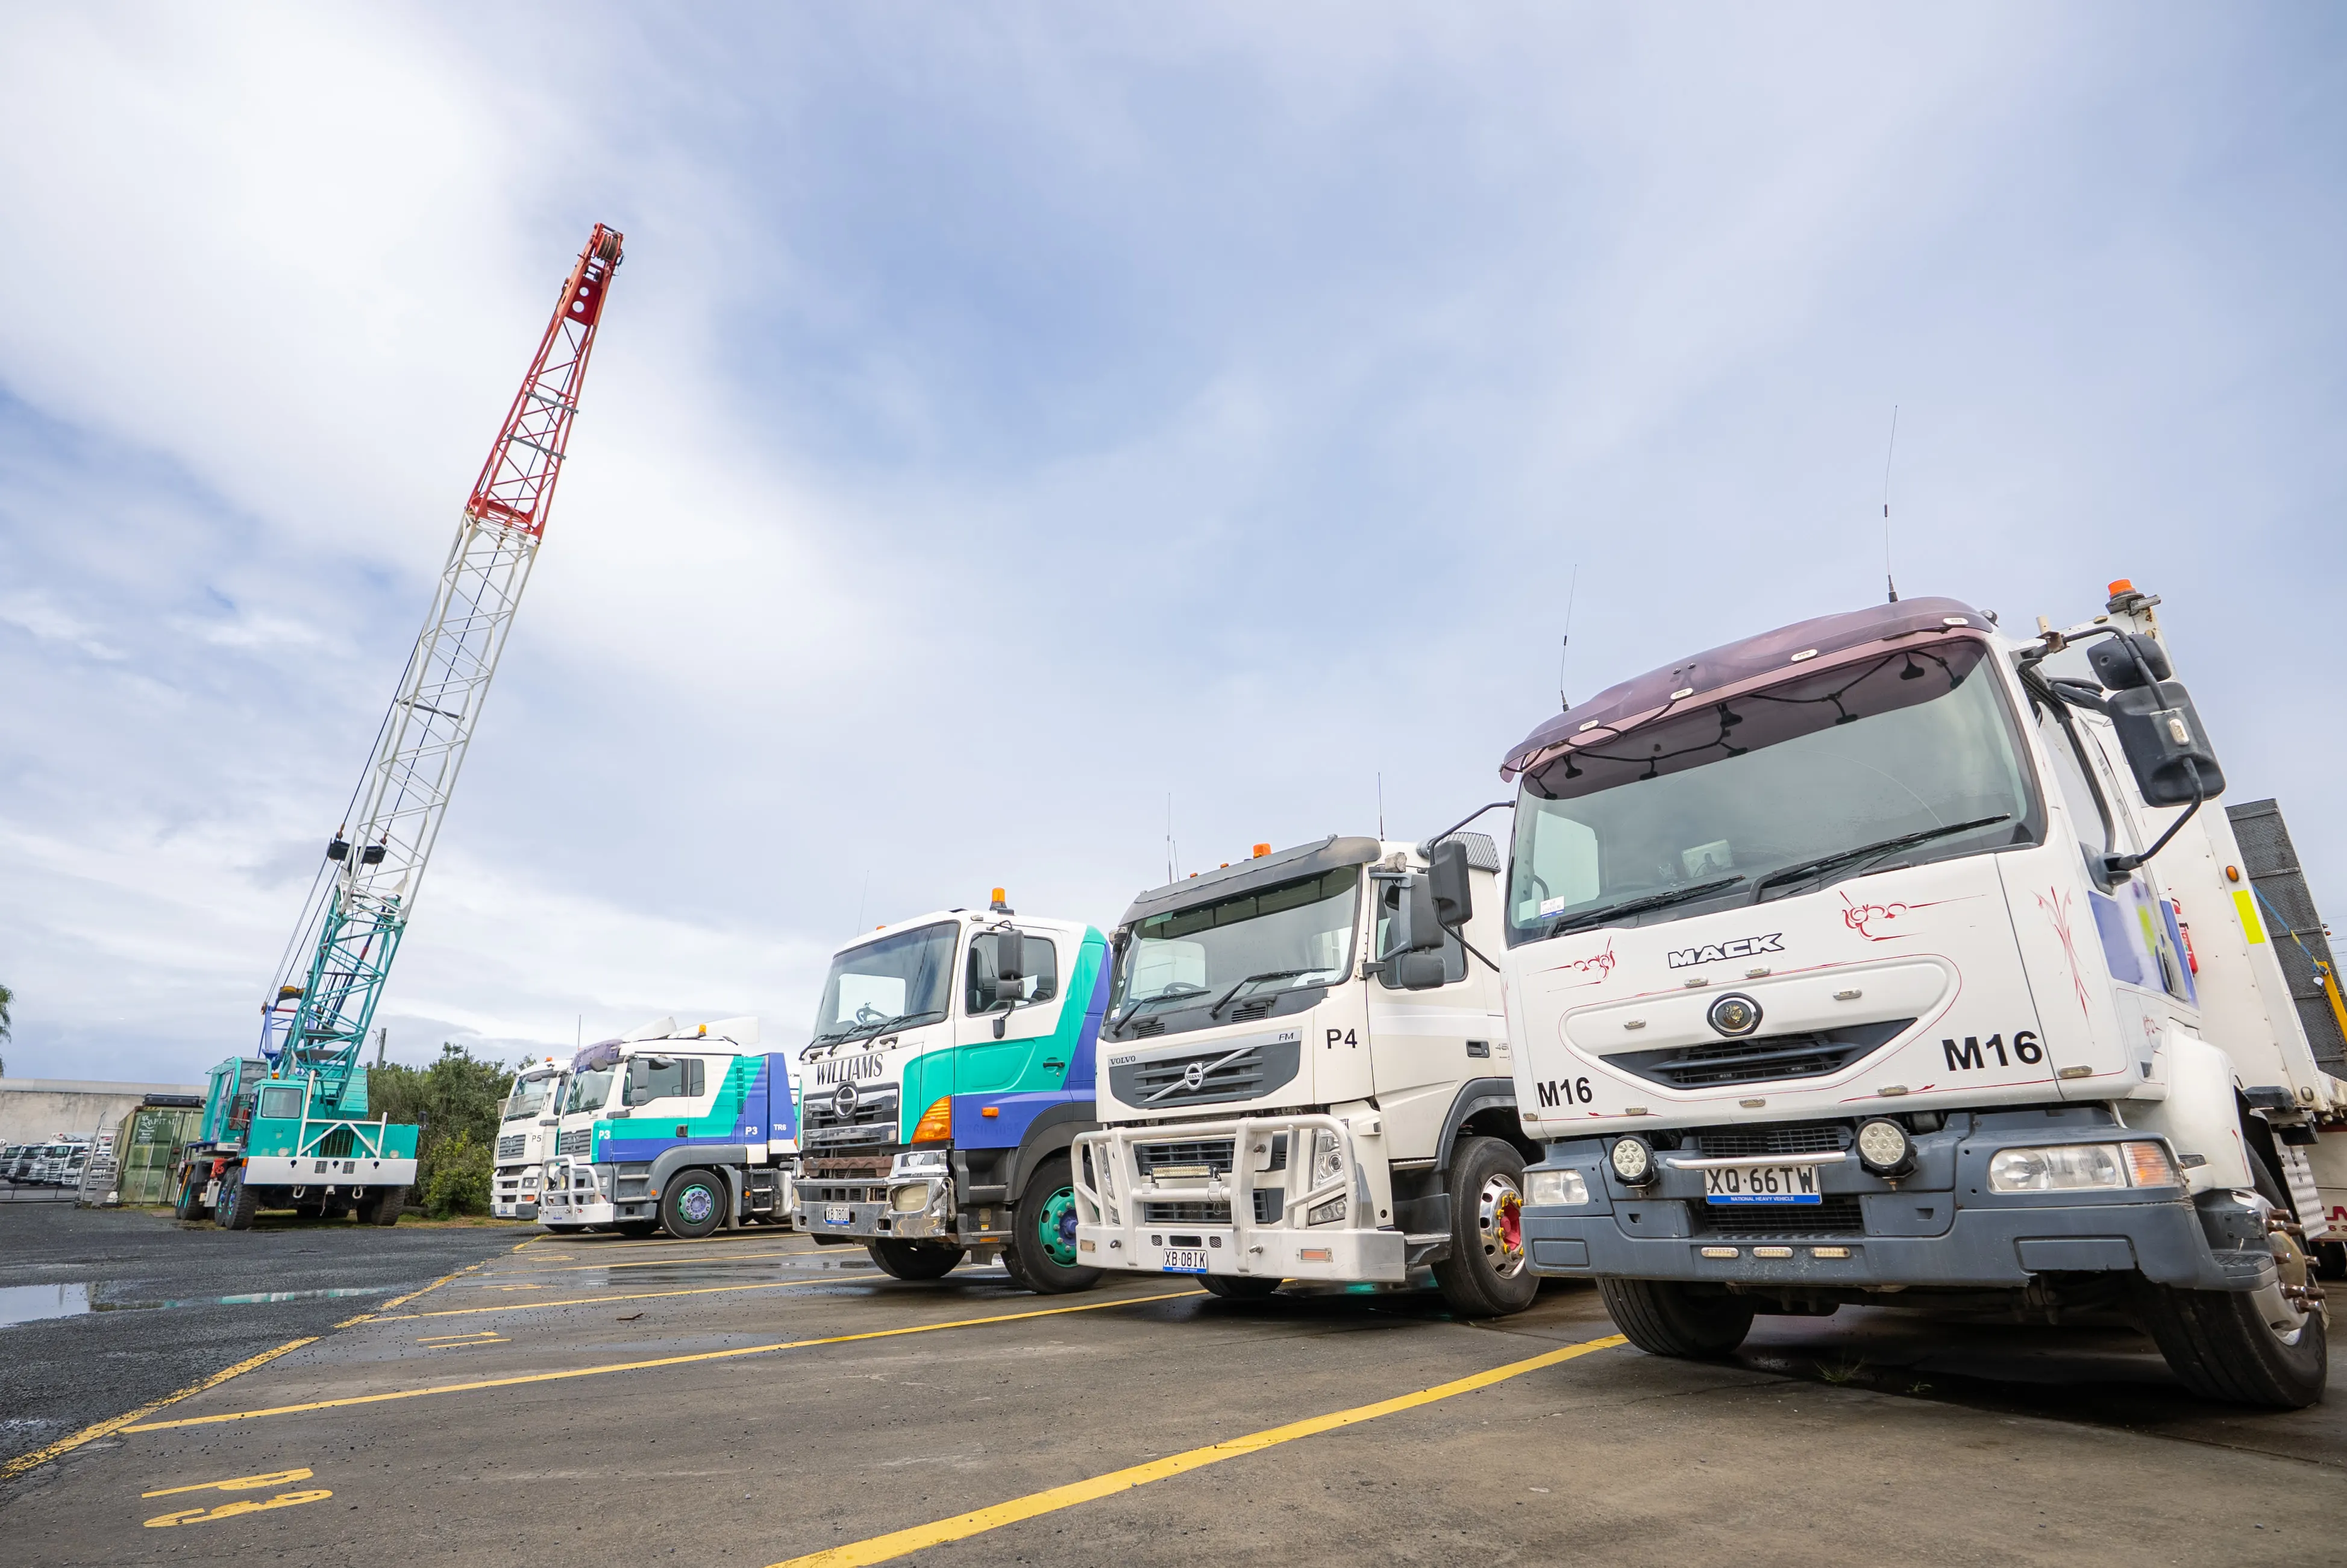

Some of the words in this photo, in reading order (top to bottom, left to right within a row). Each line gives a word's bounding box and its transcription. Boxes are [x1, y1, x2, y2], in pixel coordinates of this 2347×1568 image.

[1668, 933, 1785, 968] MACK
[1279, 1032, 1294, 1041] FM
[1326, 1028, 1358, 1049] P4
[1110, 1055, 1136, 1065] VOLVO
[1941, 1030, 2043, 1071] M16
[817, 1053, 883, 1085] WILLIAMS
[1537, 1076, 1593, 1108] M16
[598, 1129, 610, 1140] P3
[745, 1126, 758, 1135] P3
